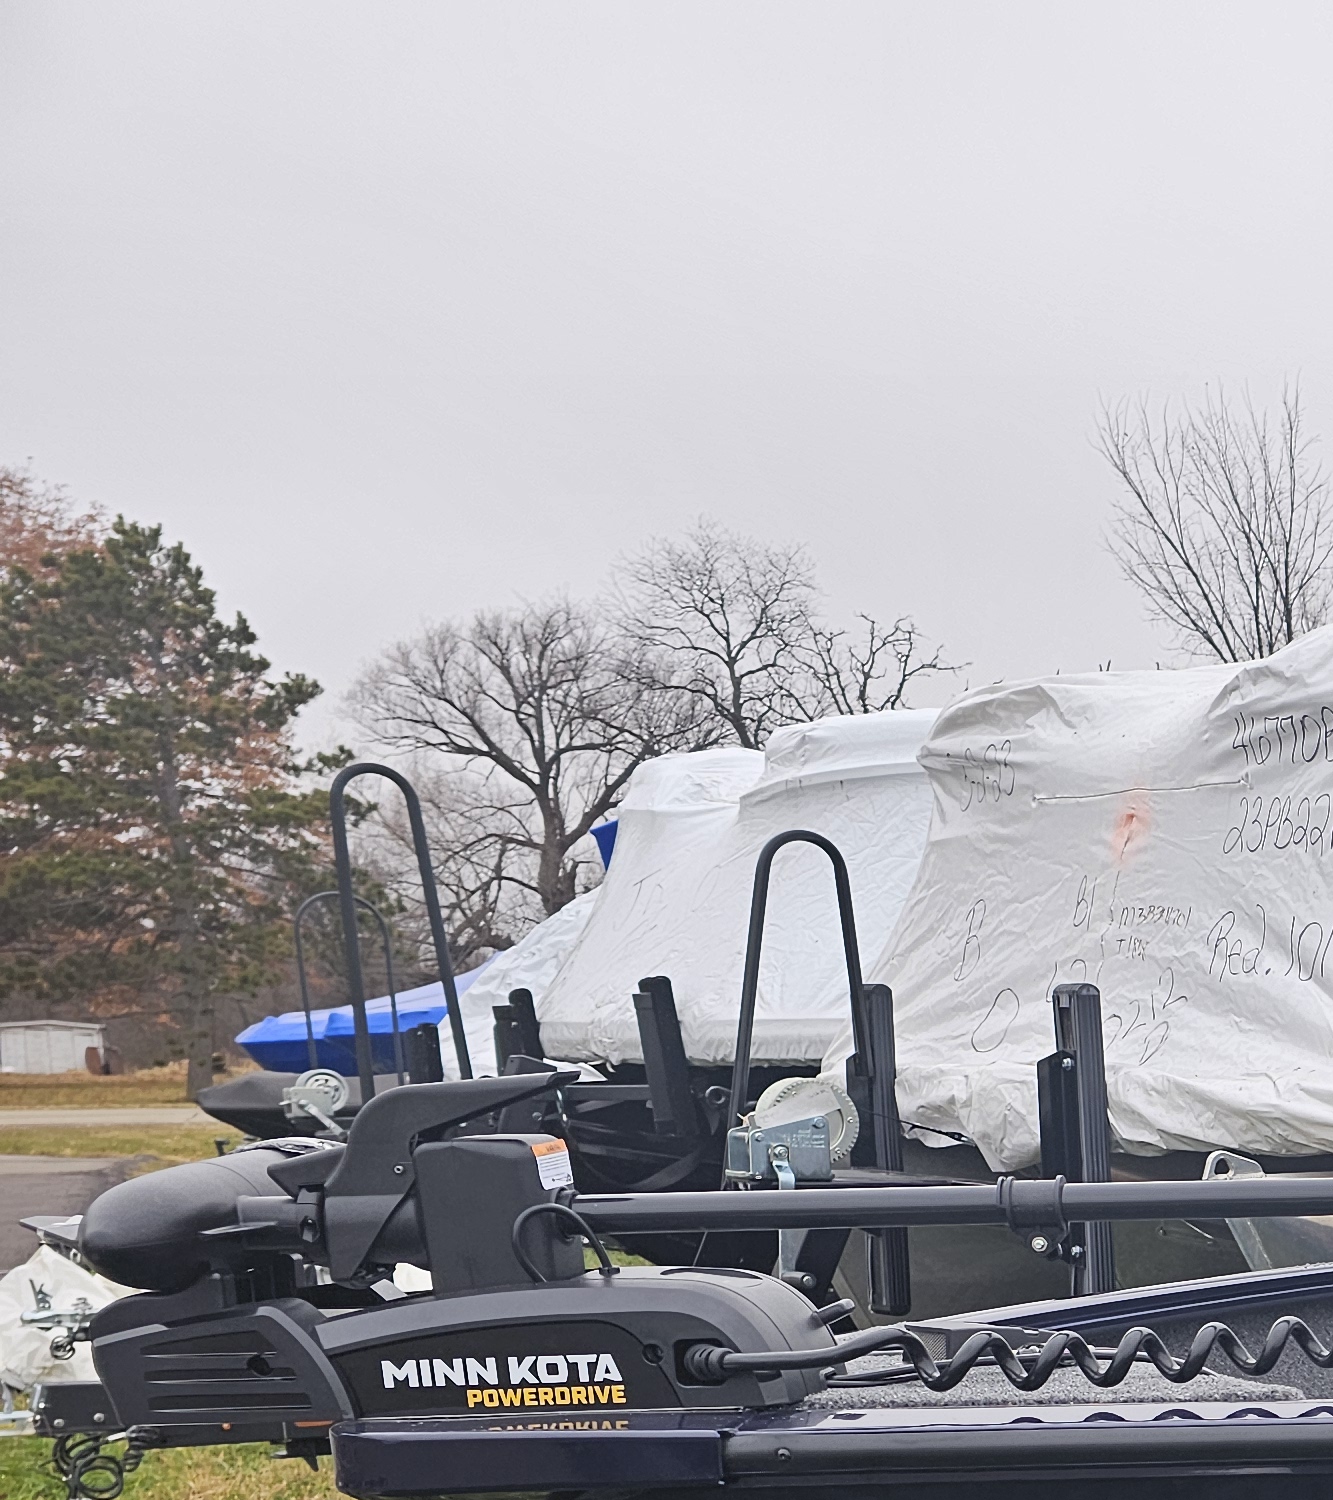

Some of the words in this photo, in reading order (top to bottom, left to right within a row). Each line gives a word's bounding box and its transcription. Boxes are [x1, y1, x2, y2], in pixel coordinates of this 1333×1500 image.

[381, 1356, 499, 1389] MINN
[507, 1353, 623, 1385] KOTA
[466, 1384, 627, 1408] POWERDRIVE
